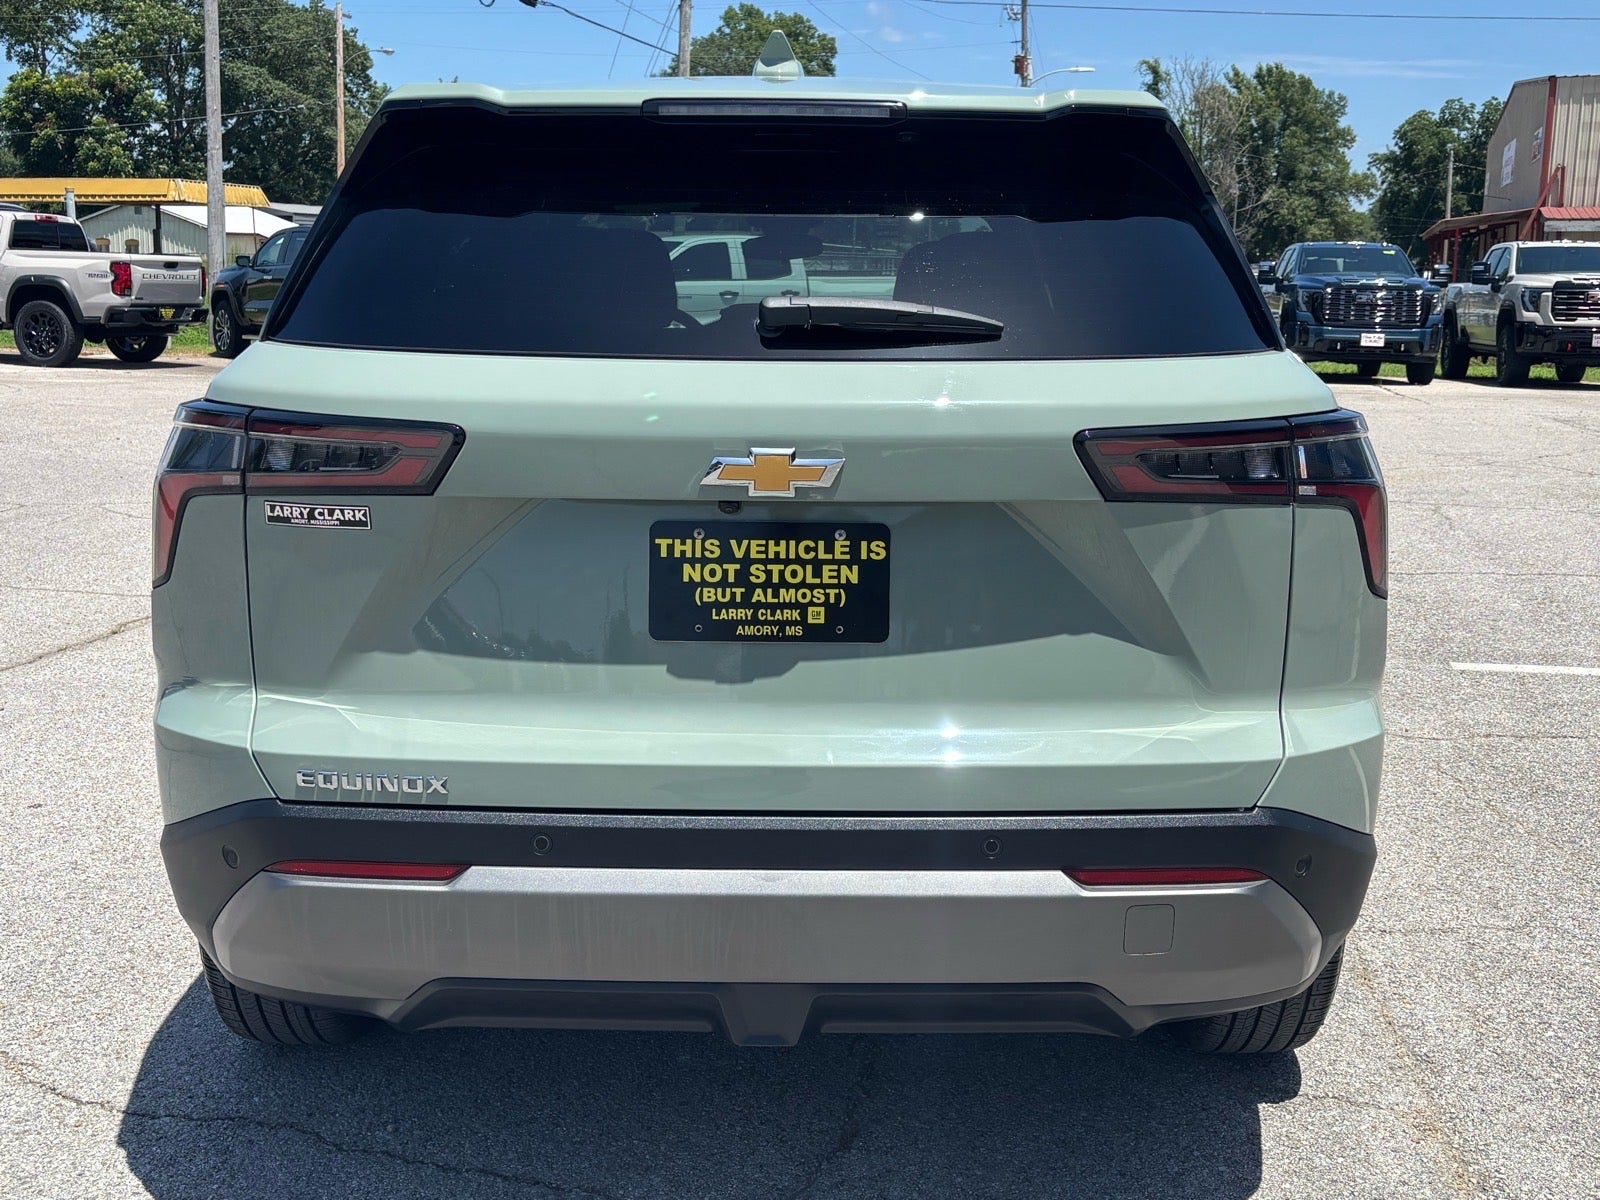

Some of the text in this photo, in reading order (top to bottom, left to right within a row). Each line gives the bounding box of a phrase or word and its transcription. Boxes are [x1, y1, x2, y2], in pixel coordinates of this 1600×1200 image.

[266, 505, 367, 521] LARRY CLARK
[655, 538, 887, 560] THIS VEHICLE IS
[682, 563, 859, 584] NOT STOLEN
[695, 587, 846, 607] (BUT ALMOST)
[712, 608, 800, 621] LARRY CLARK
[736, 625, 803, 637] AMORY, MS
[296, 769, 449, 794] EQUINOX
